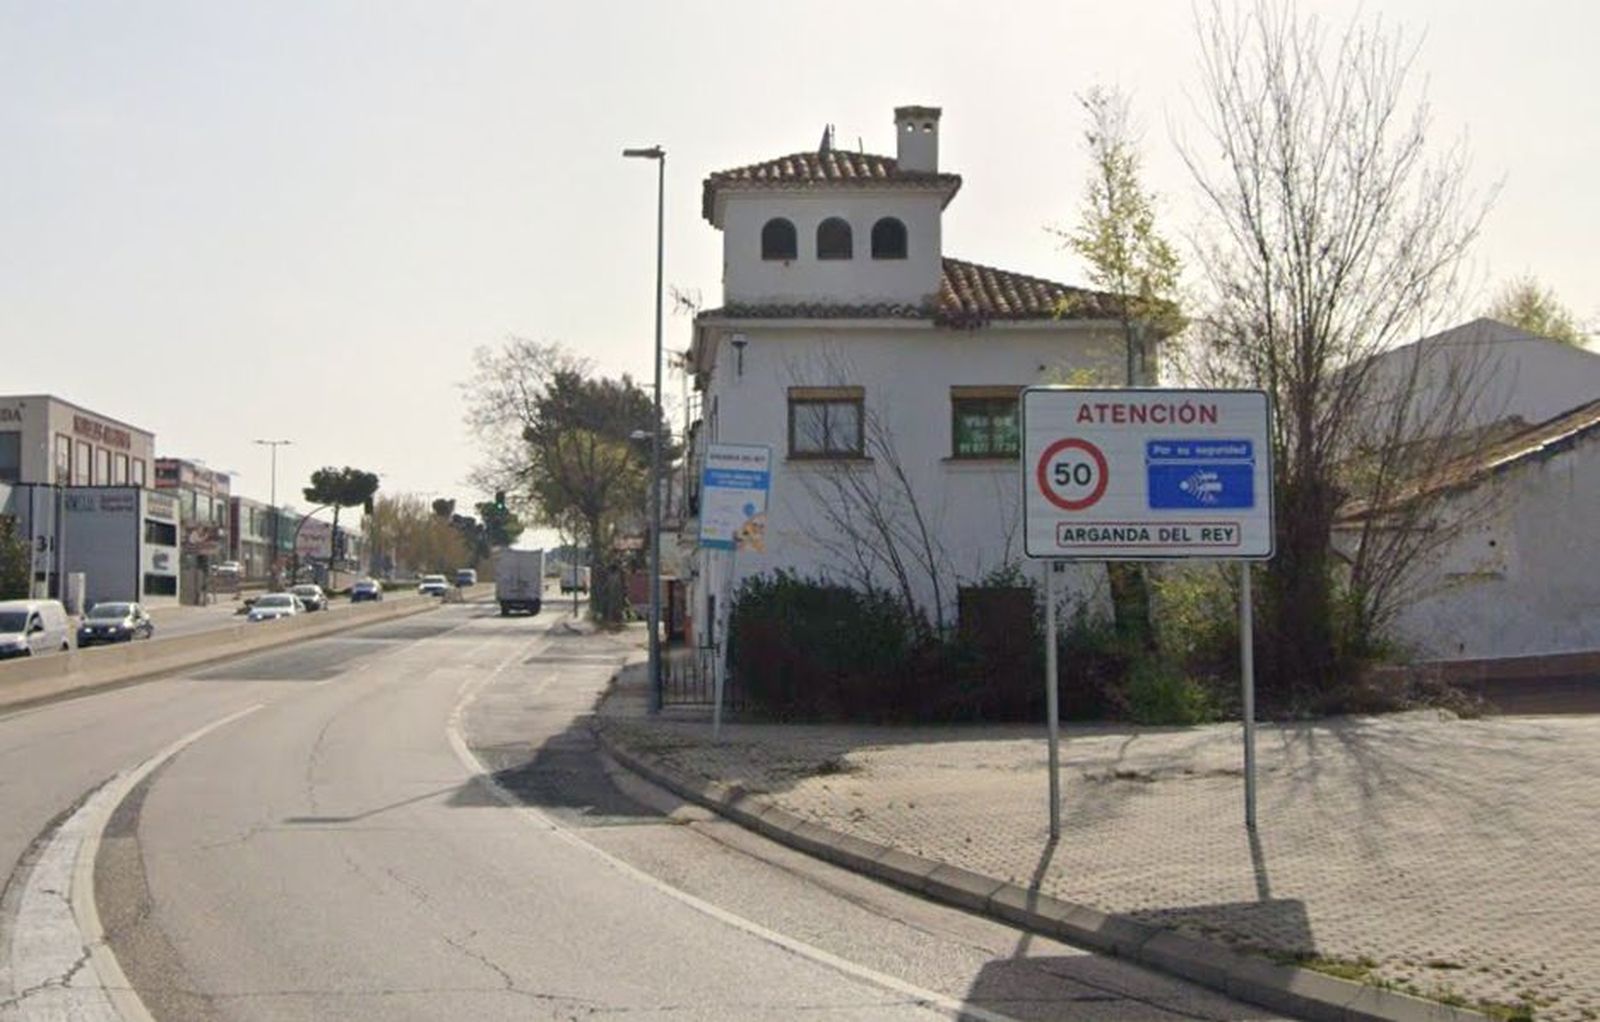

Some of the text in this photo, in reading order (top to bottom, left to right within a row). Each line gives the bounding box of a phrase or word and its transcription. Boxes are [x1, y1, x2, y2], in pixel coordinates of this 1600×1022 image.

[1076, 401, 1218, 424] ATENCIÓN
[1054, 463, 1092, 486] 50
[1063, 527, 1234, 543] ARGANDA DEL REY
